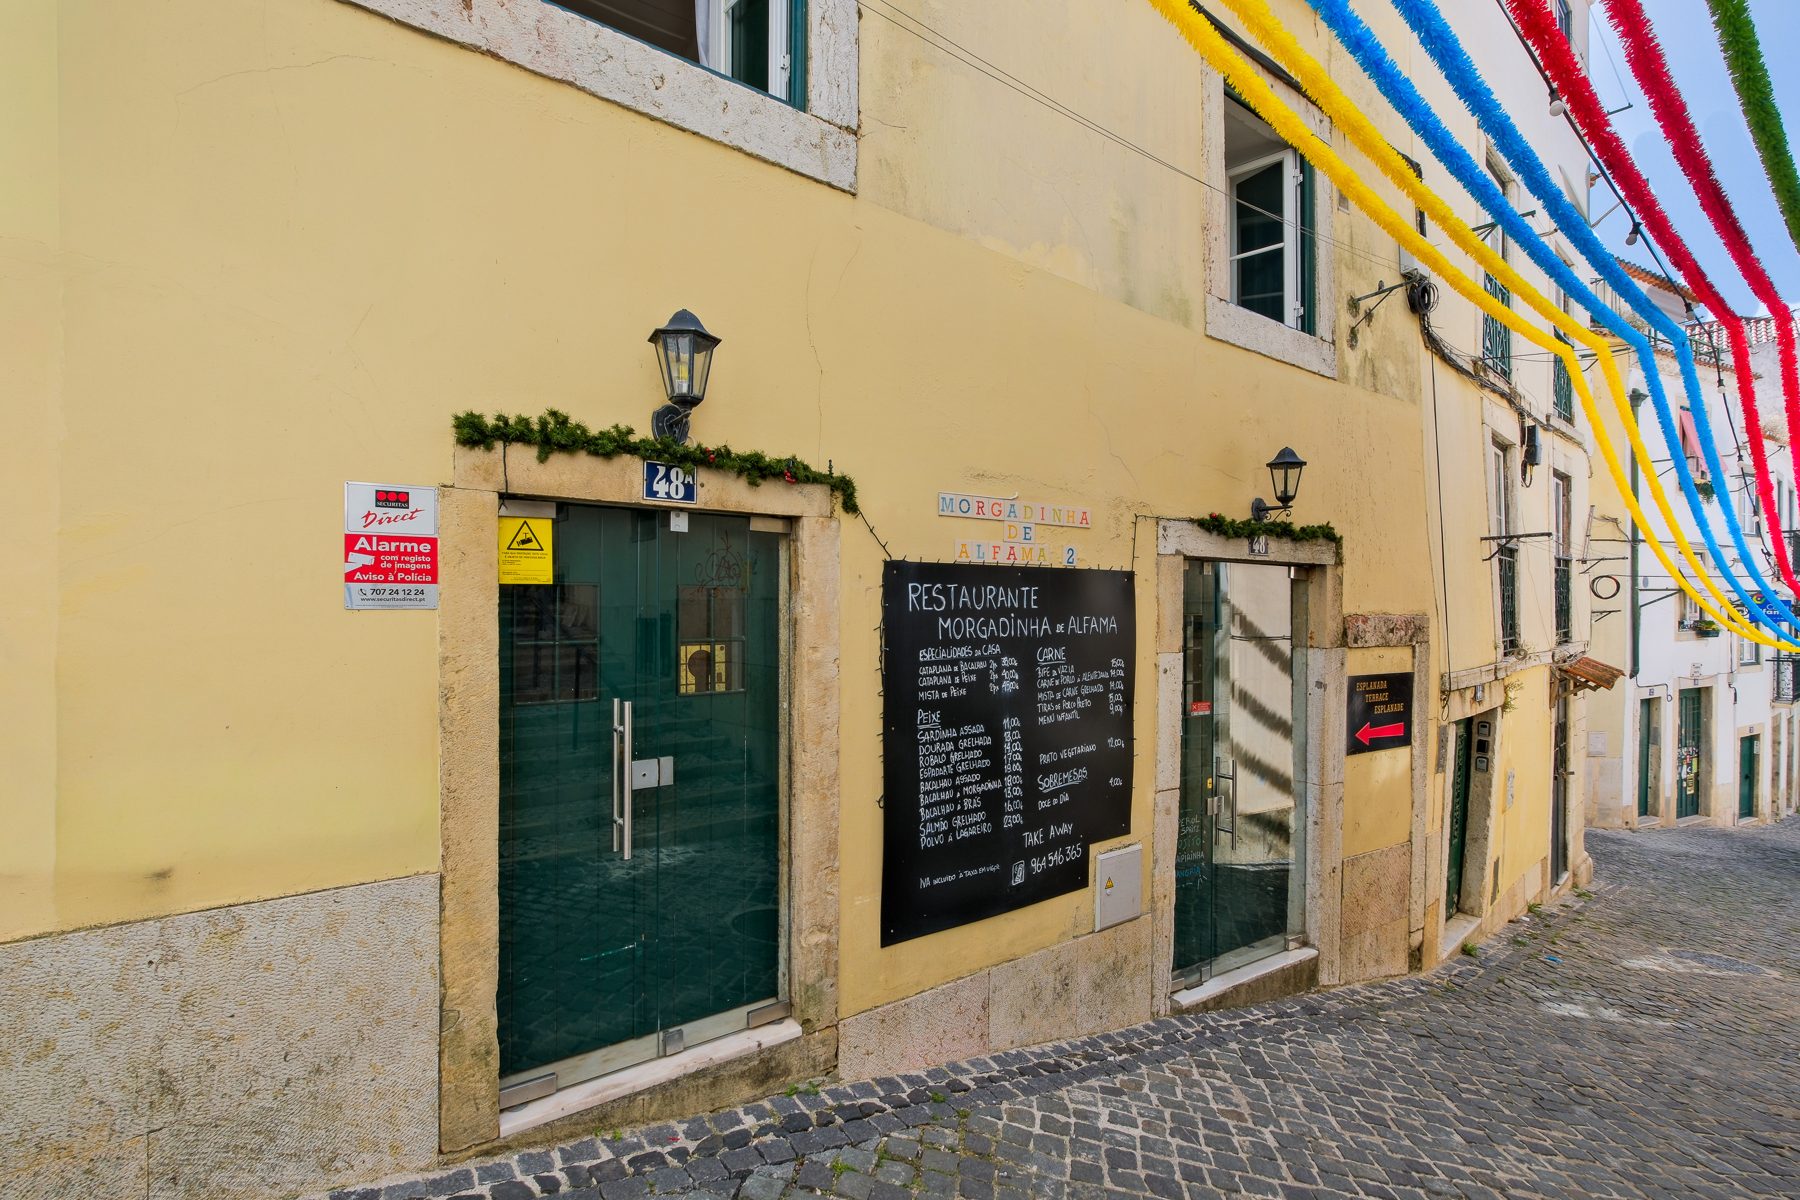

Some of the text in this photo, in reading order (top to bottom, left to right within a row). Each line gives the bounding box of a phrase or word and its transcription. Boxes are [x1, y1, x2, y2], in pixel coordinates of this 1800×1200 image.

[361, 508, 425, 528] Direct
[940, 496, 1089, 525] MORGADINHA
[1007, 524, 1032, 541] DE
[354, 536, 431, 553] Alarme
[401, 554, 431, 563] registo
[958, 543, 1075, 565] ALFAMA 2
[394, 562, 431, 571] imagens
[354, 572, 432, 582] Aviso à Polícia
[414, 589, 425, 597] 24
[908, 583, 1039, 612] RESTAURANTE
[938, 612, 1118, 640] MORGADINHA DE ALFAMA
[982, 644, 1001, 656] CASA
[1037, 647, 1066, 662] CARNE
[919, 665, 952, 676] CATAPLANA
[919, 675, 952, 687] CATAPLANA
[919, 690, 940, 701] MISTA
[1037, 702, 1054, 713] TIRAS
[918, 709, 940, 725] PEIXE
[917, 728, 957, 743] SARDINHA
[919, 741, 955, 756] DOURADA
[919, 754, 946, 768] ROBALO
[1039, 752, 1058, 765] PRATO
[919, 764, 953, 780] ESPADARTE
[956, 759, 991, 773] GRELHADO
[920, 778, 952, 794] BACALHAU
[955, 773, 981, 786] ASSADO
[1037, 766, 1088, 792] SOBREMESAS
[919, 789, 954, 807] BACALHAU
[919, 803, 954, 821] BACALHAU
[919, 817, 949, 837] SALMÃO
[951, 811, 986, 829] GRELHADO
[920, 834, 944, 850] POLVO
[1022, 822, 1073, 848] TAKE AWAY
[1030, 842, 1082, 875] 964 546 365
